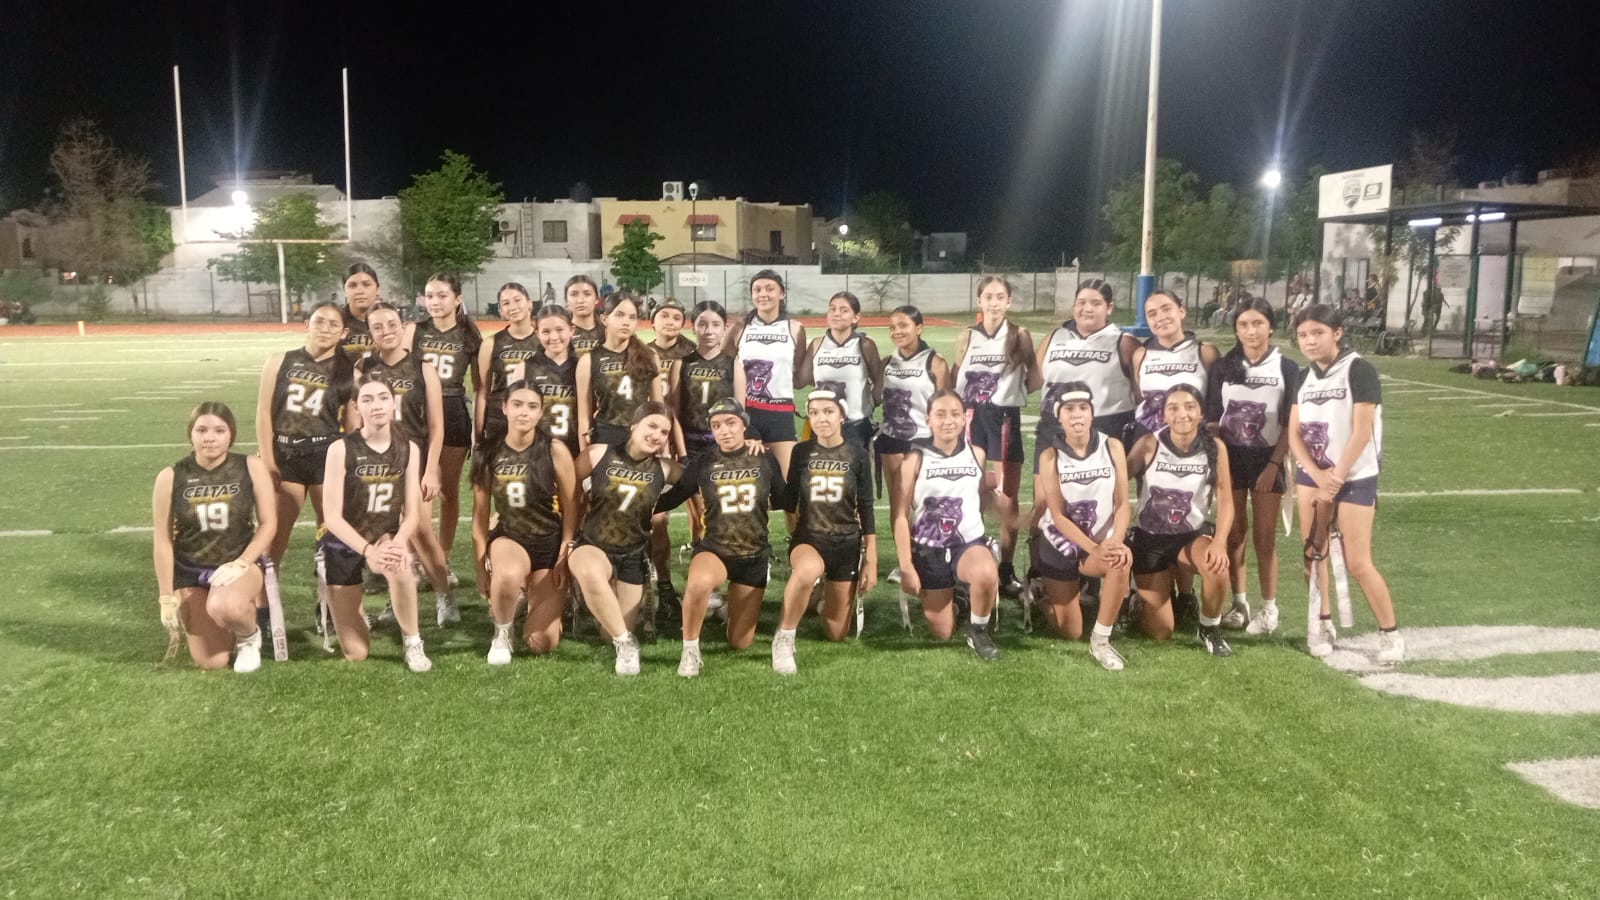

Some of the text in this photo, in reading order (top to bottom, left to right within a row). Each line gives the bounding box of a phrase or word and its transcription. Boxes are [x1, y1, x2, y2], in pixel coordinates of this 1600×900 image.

[747, 334, 787, 342] PANTERAS
[419, 341, 462, 352] CELTAS
[818, 356, 860, 366] PANTERAS
[1050, 350, 1111, 362] PANTERAS
[886, 368, 923, 377] PANTERAS
[1146, 363, 1198, 374] PANTERAS
[616, 375, 633, 400] 4
[701, 381, 710, 403] 1
[286, 383, 325, 415] 24
[550, 403, 570, 435] 3
[606, 466, 654, 483] CELTAS
[710, 468, 760, 481] CELTAS
[808, 461, 849, 472] CELTAS
[927, 467, 977, 479] PANTERAS
[1157, 462, 1205, 474] PANTERAS
[1061, 468, 1111, 484] PANTERAS
[183, 483, 240, 499] CELTAS
[506, 482, 526, 507] 8
[810, 475, 844, 502] 25
[367, 483, 394, 513] 12
[619, 484, 637, 512] 7
[718, 483, 757, 514] 23
[196, 502, 229, 532] 19
